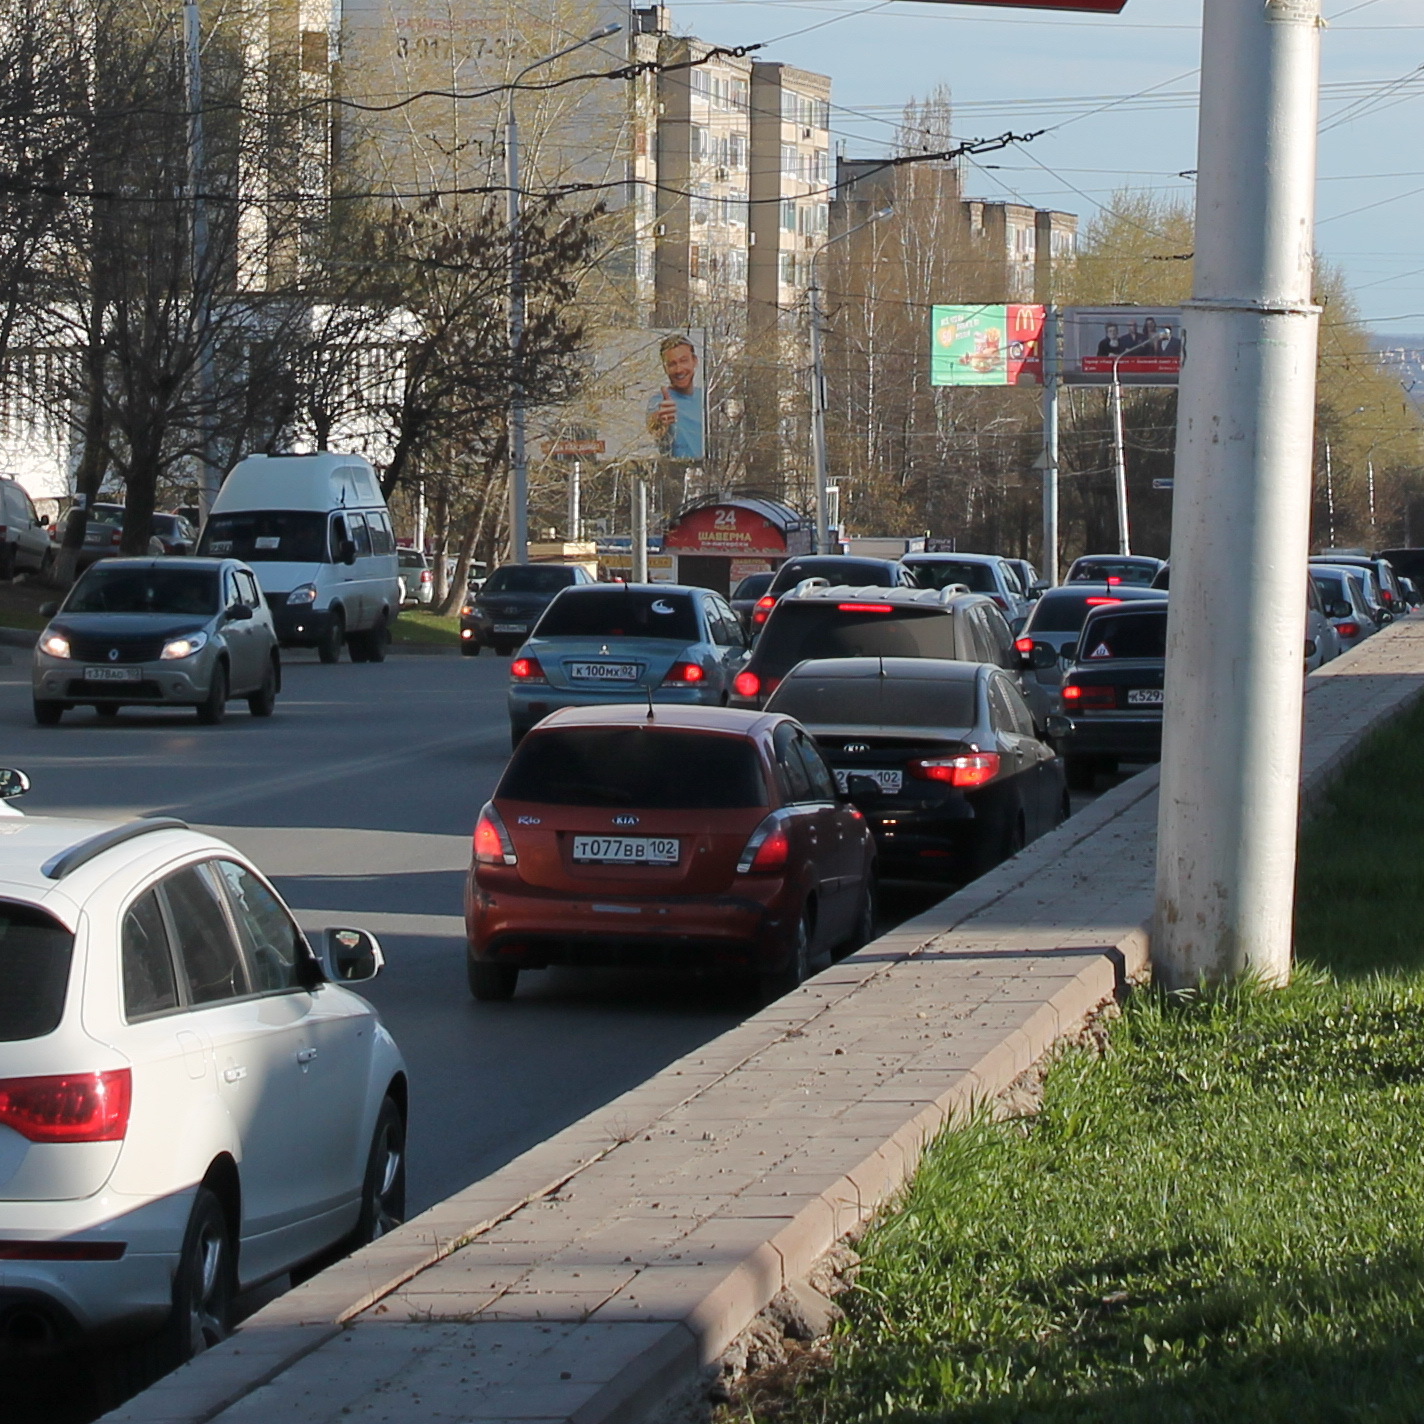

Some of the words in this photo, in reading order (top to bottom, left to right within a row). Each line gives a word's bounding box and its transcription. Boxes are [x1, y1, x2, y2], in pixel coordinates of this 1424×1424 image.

[715, 510, 736, 525] 24
[698, 531, 752, 542] ШАВЕРМА
[1130, 691, 1165, 702] К529
[878, 771, 898, 783] 102
[518, 816, 541, 825] Rio
[616, 816, 635, 825] KIA
[580, 840, 644, 857] Т077ВВ
[650, 841, 674, 854] 102
